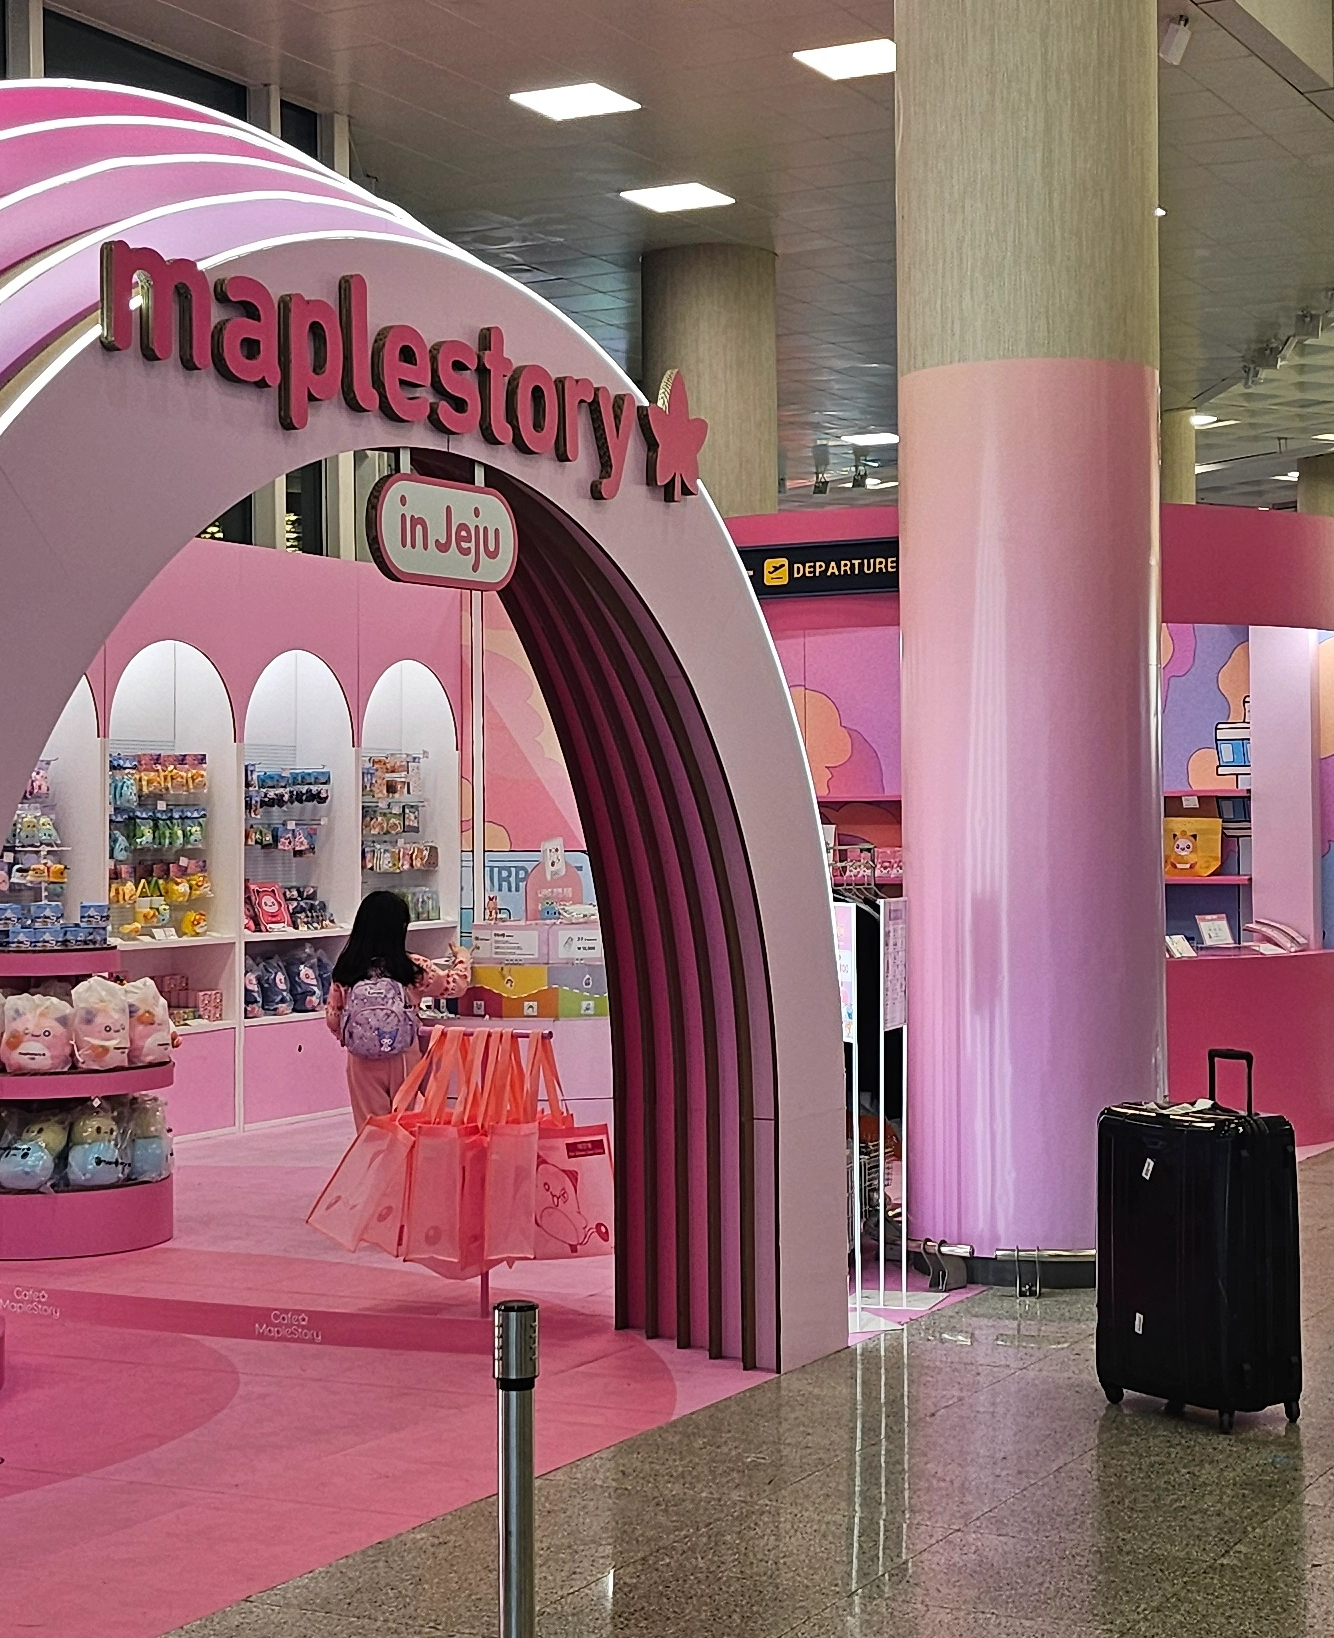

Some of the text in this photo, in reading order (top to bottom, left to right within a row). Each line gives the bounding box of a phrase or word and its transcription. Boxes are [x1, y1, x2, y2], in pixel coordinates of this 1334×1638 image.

[100, 239, 636, 500] maplestory
[400, 494, 500, 573] in Jeju
[793, 557, 897, 578] DEPARTURE
[13, 1286, 40, 1301] Cafe
[0, 1298, 60, 1320] MapleStory
[270, 1310, 299, 1325] Cafe
[254, 1322, 322, 1343] MapleStory
